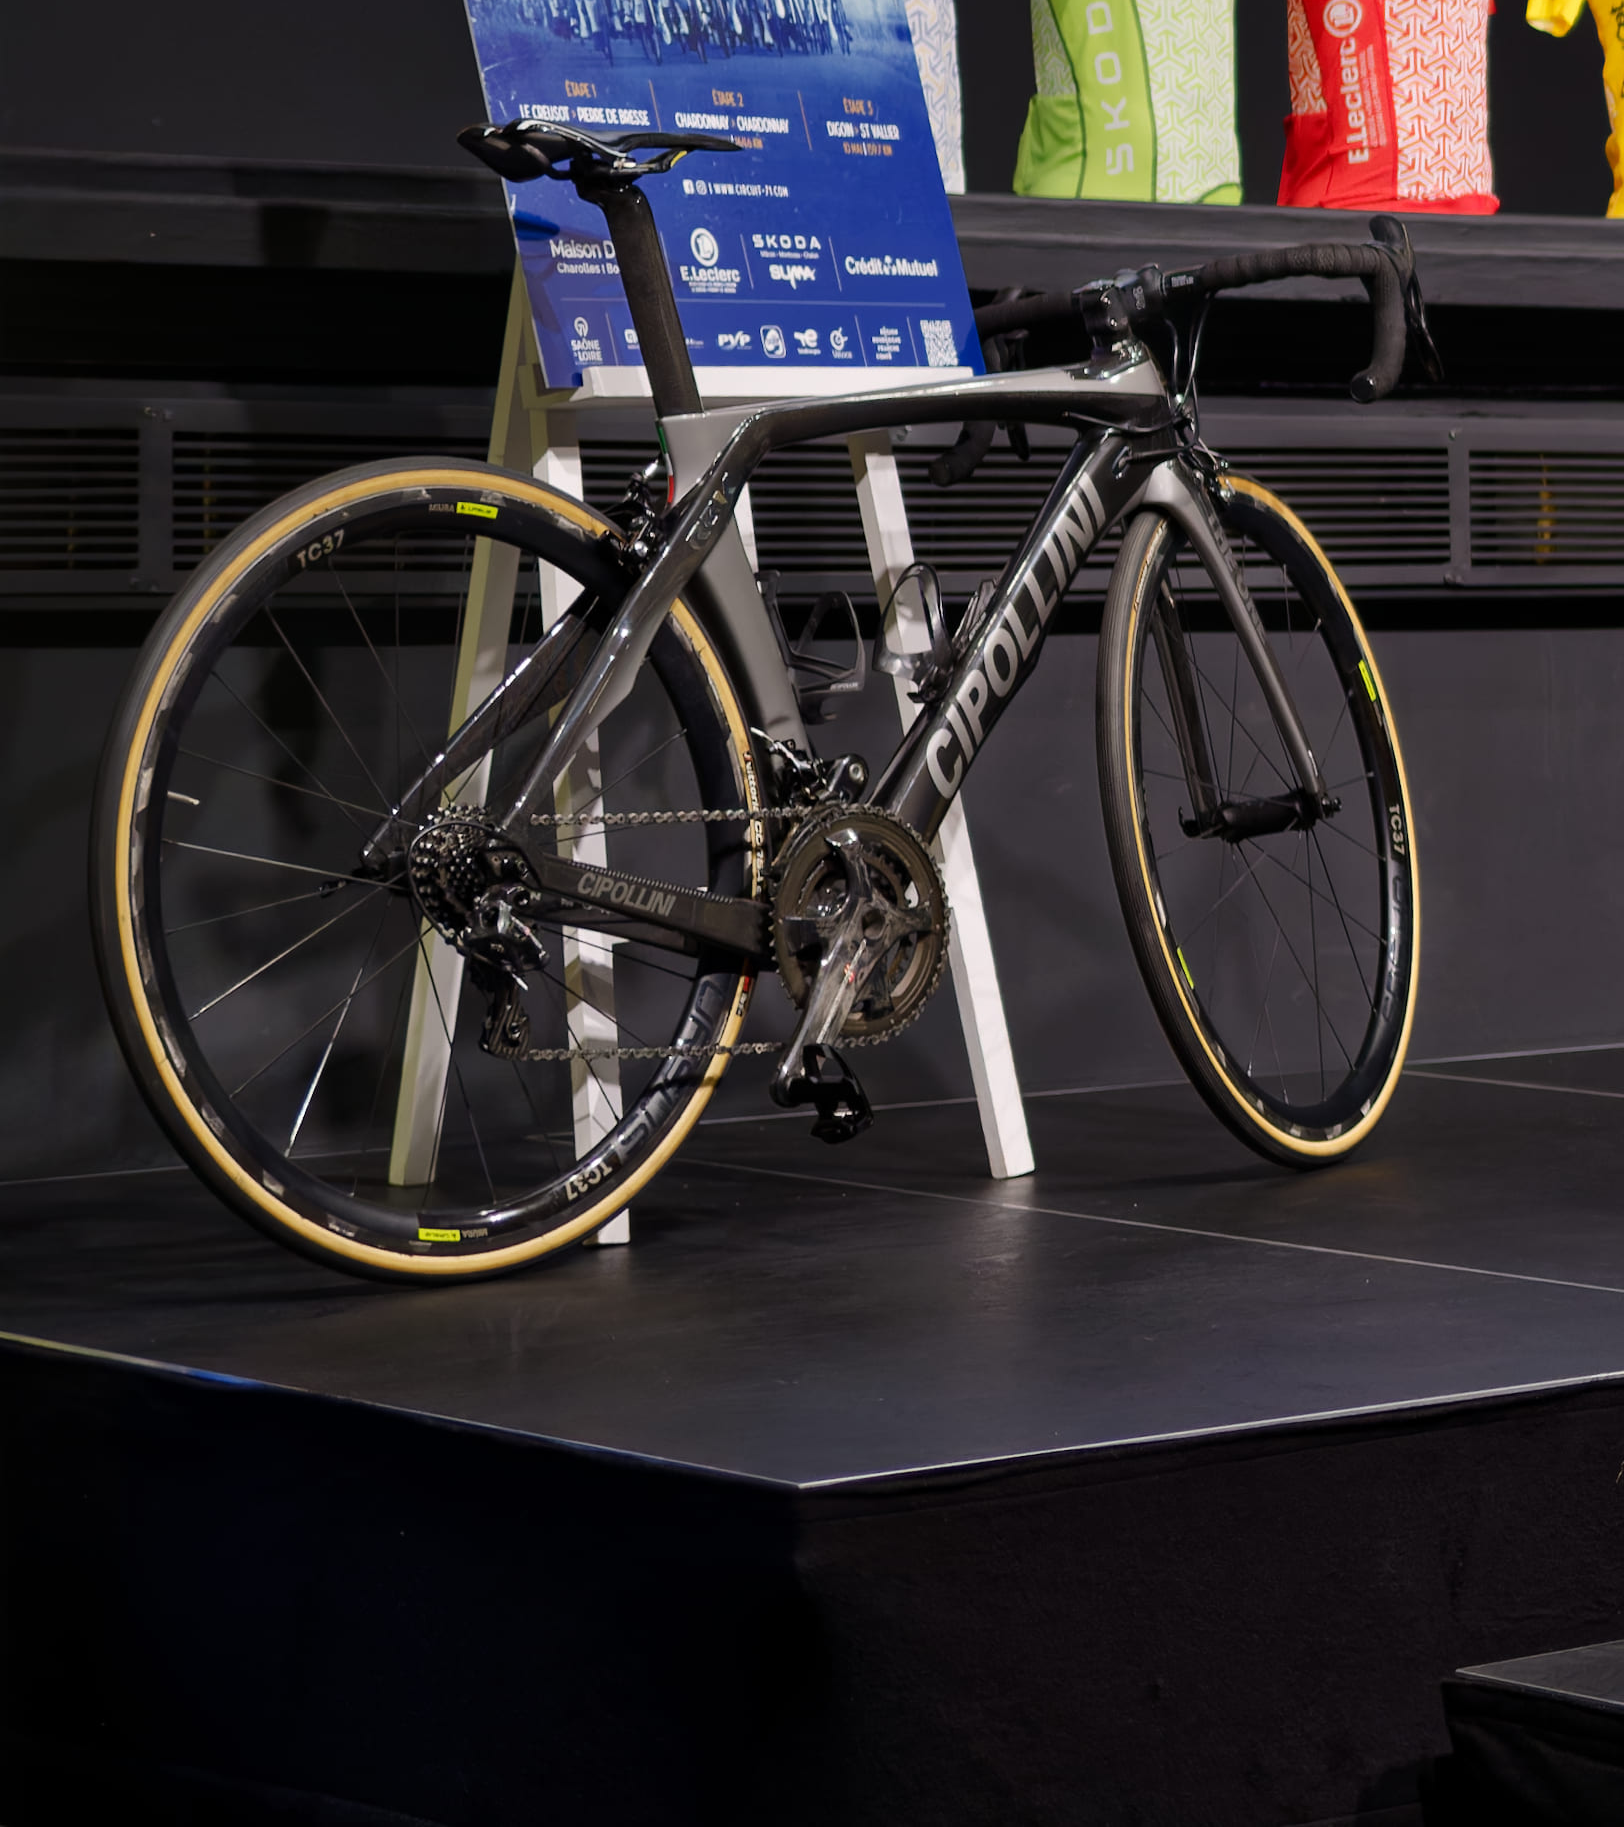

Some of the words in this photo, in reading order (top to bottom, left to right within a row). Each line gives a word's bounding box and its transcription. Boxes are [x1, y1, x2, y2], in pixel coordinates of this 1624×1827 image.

[549, 239, 603, 260] Maison
[752, 234, 822, 251] SKODA
[679, 265, 741, 284] E.Leclerc
[844, 255, 882, 277] Crédit
[896, 257, 939, 277] Mutuel
[296, 528, 345, 569] TC37
[926, 472, 1106, 800] CIPOLLINI
[1388, 803, 1406, 858] TC37
[577, 872, 677, 918] CIPOLLINI
[565, 1160, 613, 1201] TC37
